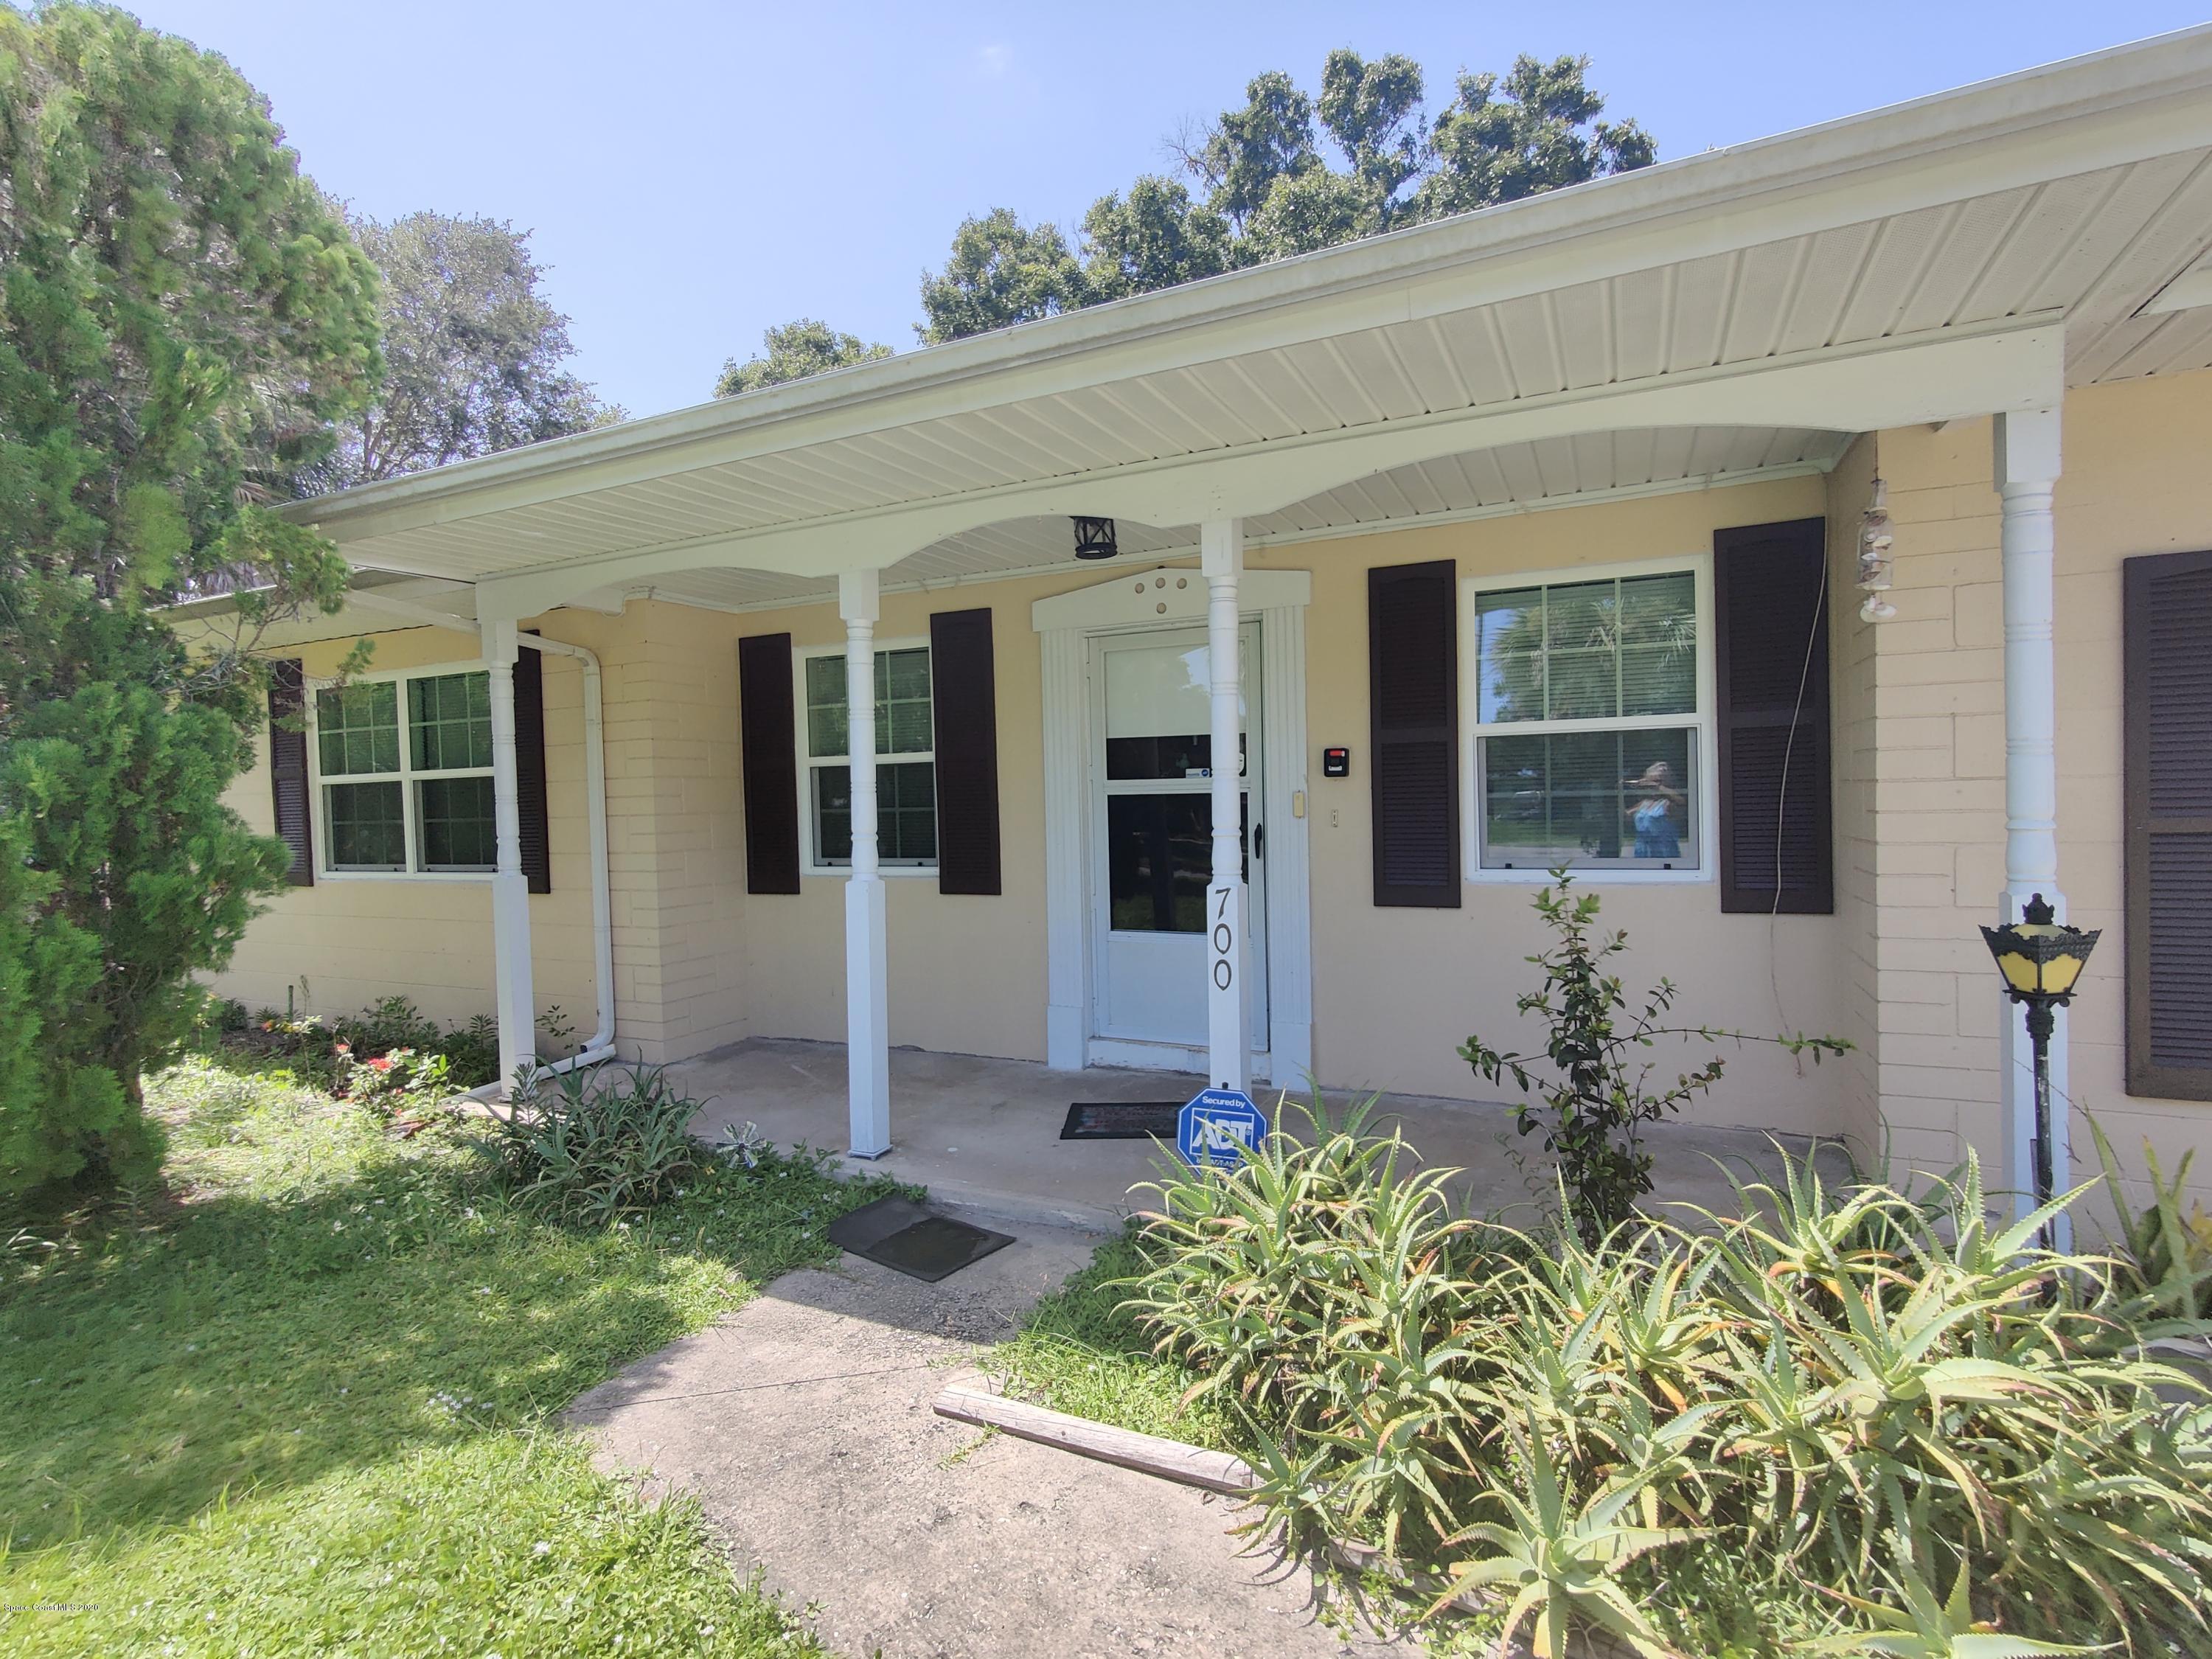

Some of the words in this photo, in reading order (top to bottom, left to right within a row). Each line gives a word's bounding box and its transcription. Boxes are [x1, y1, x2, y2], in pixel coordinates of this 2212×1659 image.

[1214, 887, 1232, 991] 700
[1202, 1096, 1235, 1106] Secured
[1235, 1099, 1246, 1109] by
[1192, 1118, 1253, 1150] ADT
